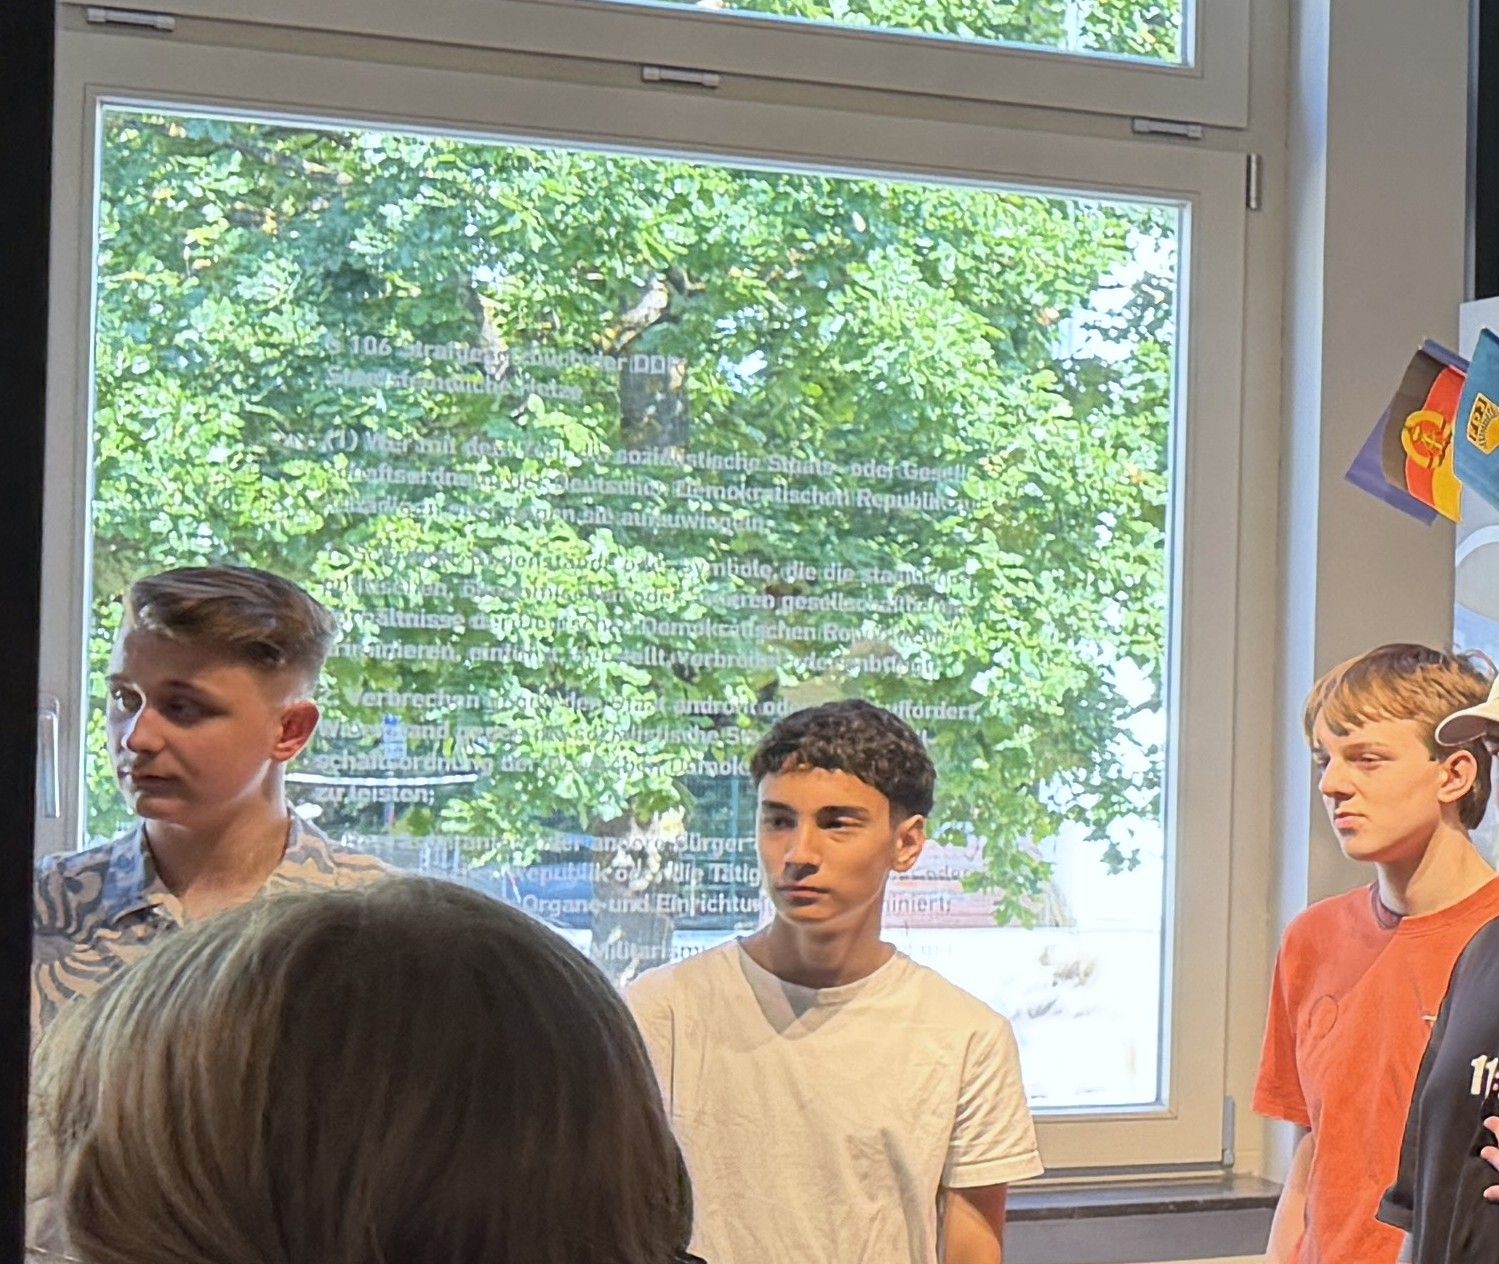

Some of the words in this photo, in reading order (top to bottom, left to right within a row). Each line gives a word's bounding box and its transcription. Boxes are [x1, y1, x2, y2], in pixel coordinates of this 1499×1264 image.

[349, 335, 392, 356] 106
[712, 863, 759, 887] Tätig
[656, 895, 772, 913] Einrichtun
